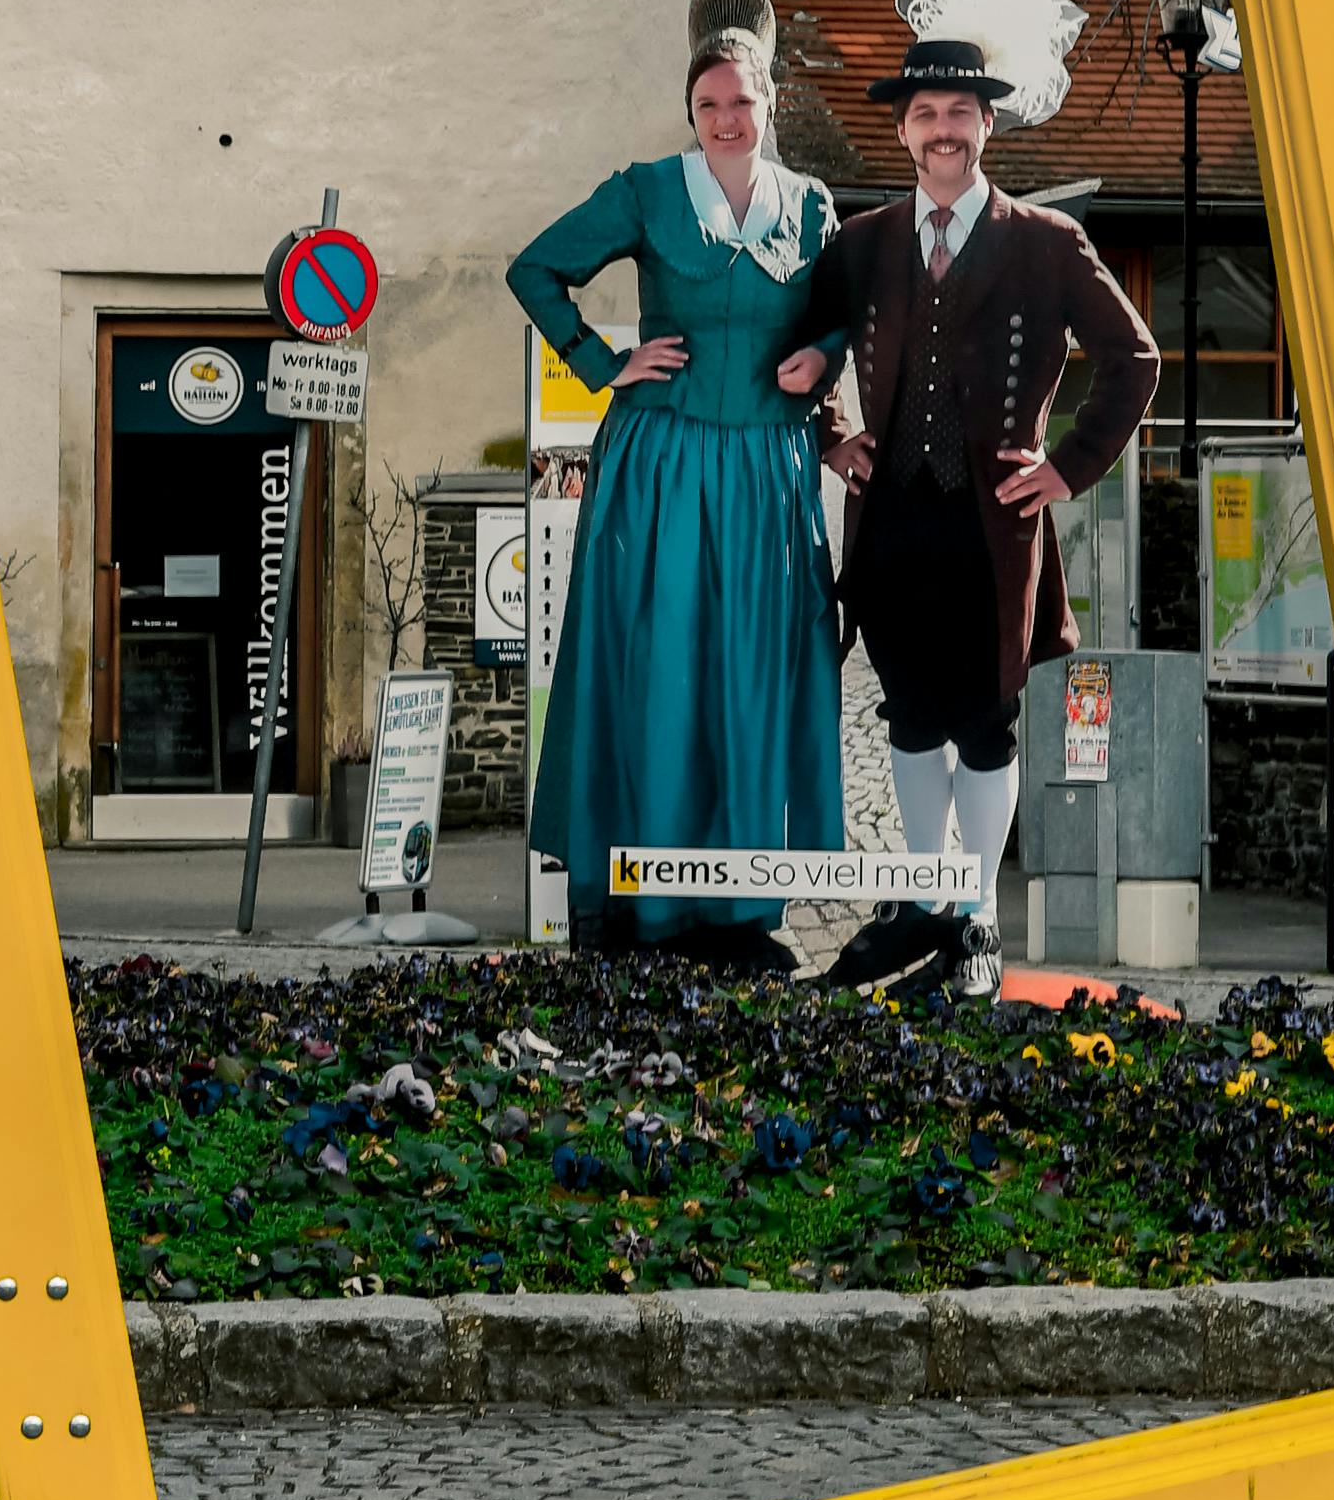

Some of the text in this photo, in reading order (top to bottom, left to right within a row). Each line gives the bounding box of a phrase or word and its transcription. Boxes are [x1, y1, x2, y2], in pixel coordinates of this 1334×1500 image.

[300, 321, 348, 339] ANFANG
[290, 396, 302, 410] Sa
[247, 444, 290, 751] Willkommen
[619, 851, 978, 891] krems. So viel mehr.
